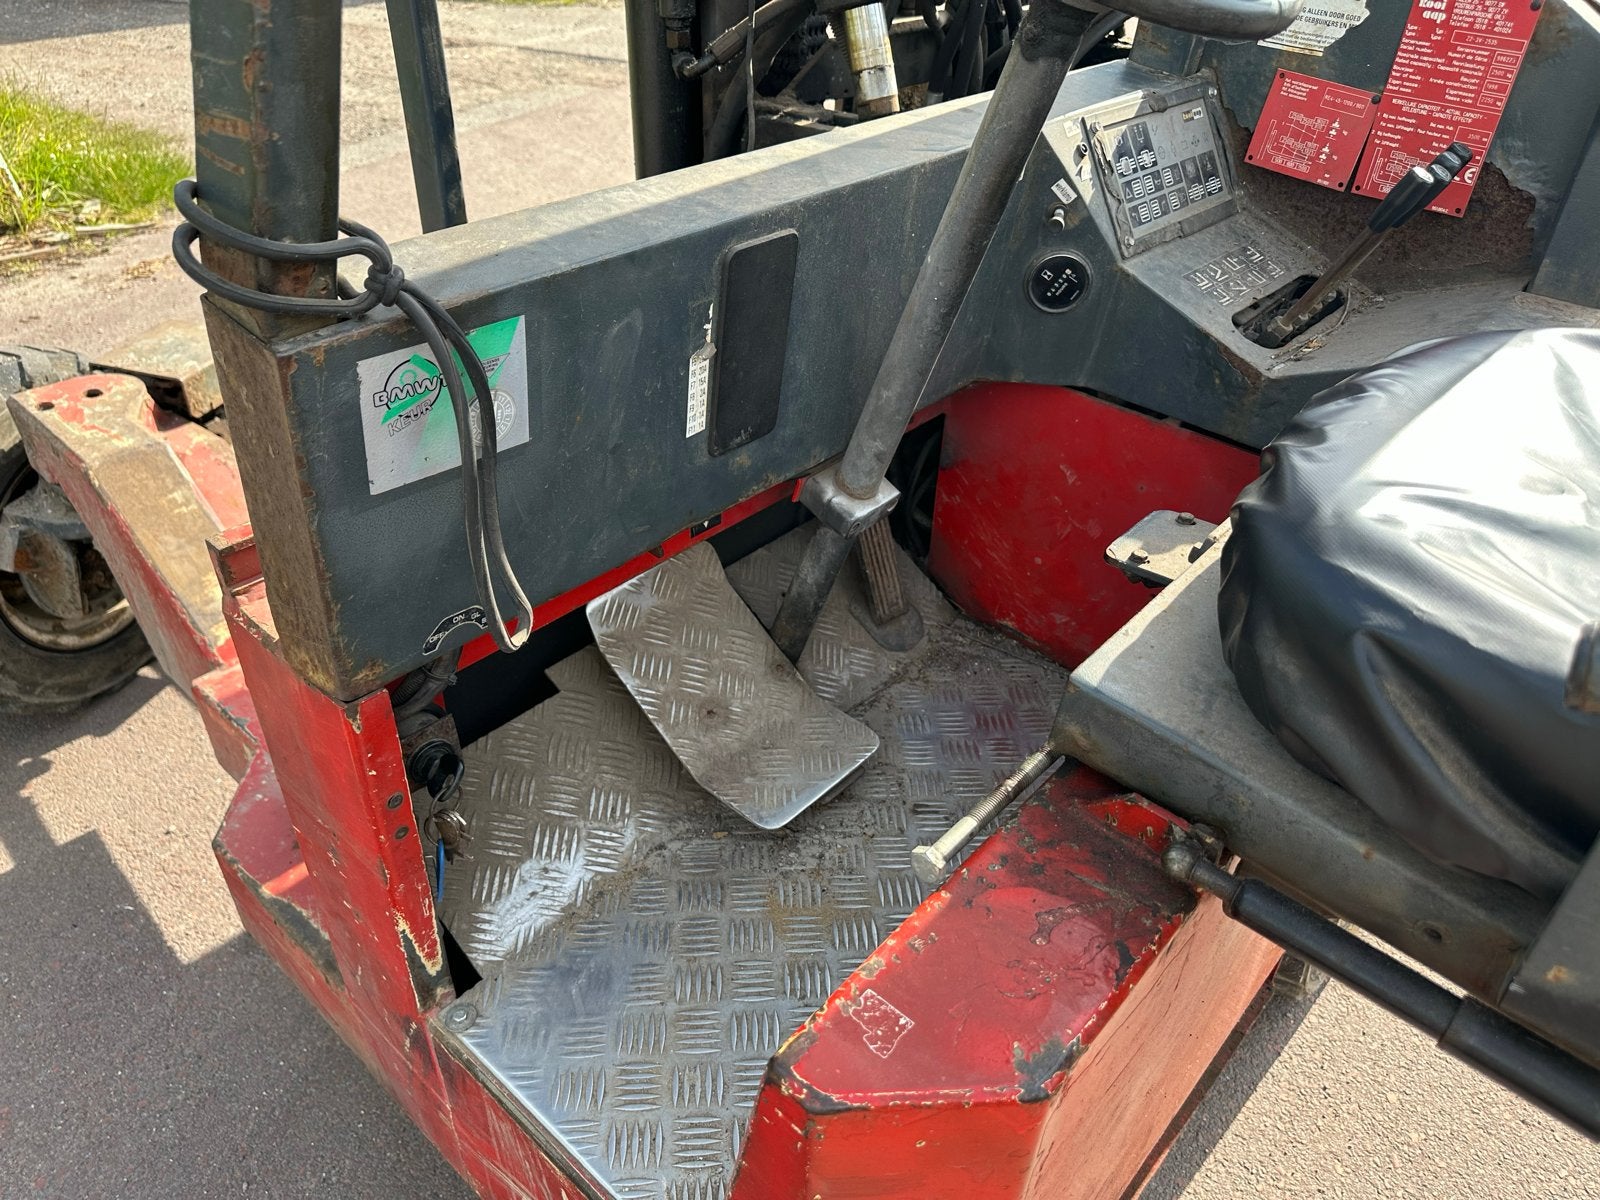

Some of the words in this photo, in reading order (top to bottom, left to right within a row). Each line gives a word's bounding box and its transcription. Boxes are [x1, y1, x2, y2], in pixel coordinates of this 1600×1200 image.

[1308, 8, 1328, 17] ALLEEN
[1329, 11, 1345, 20] DOOR
[1345, 14, 1362, 22] GOED
[1451, 14, 1475, 22] Telefoon
[1305, 16, 1339, 28] GEBRUIKERS
[1449, 20, 1469, 28] Telefax
[1463, 111, 1483, 119] CAPACITY
[387, 398, 433, 437] KEUR
[453, 613, 465, 623] ON
[430, 631, 445, 643] OFF
